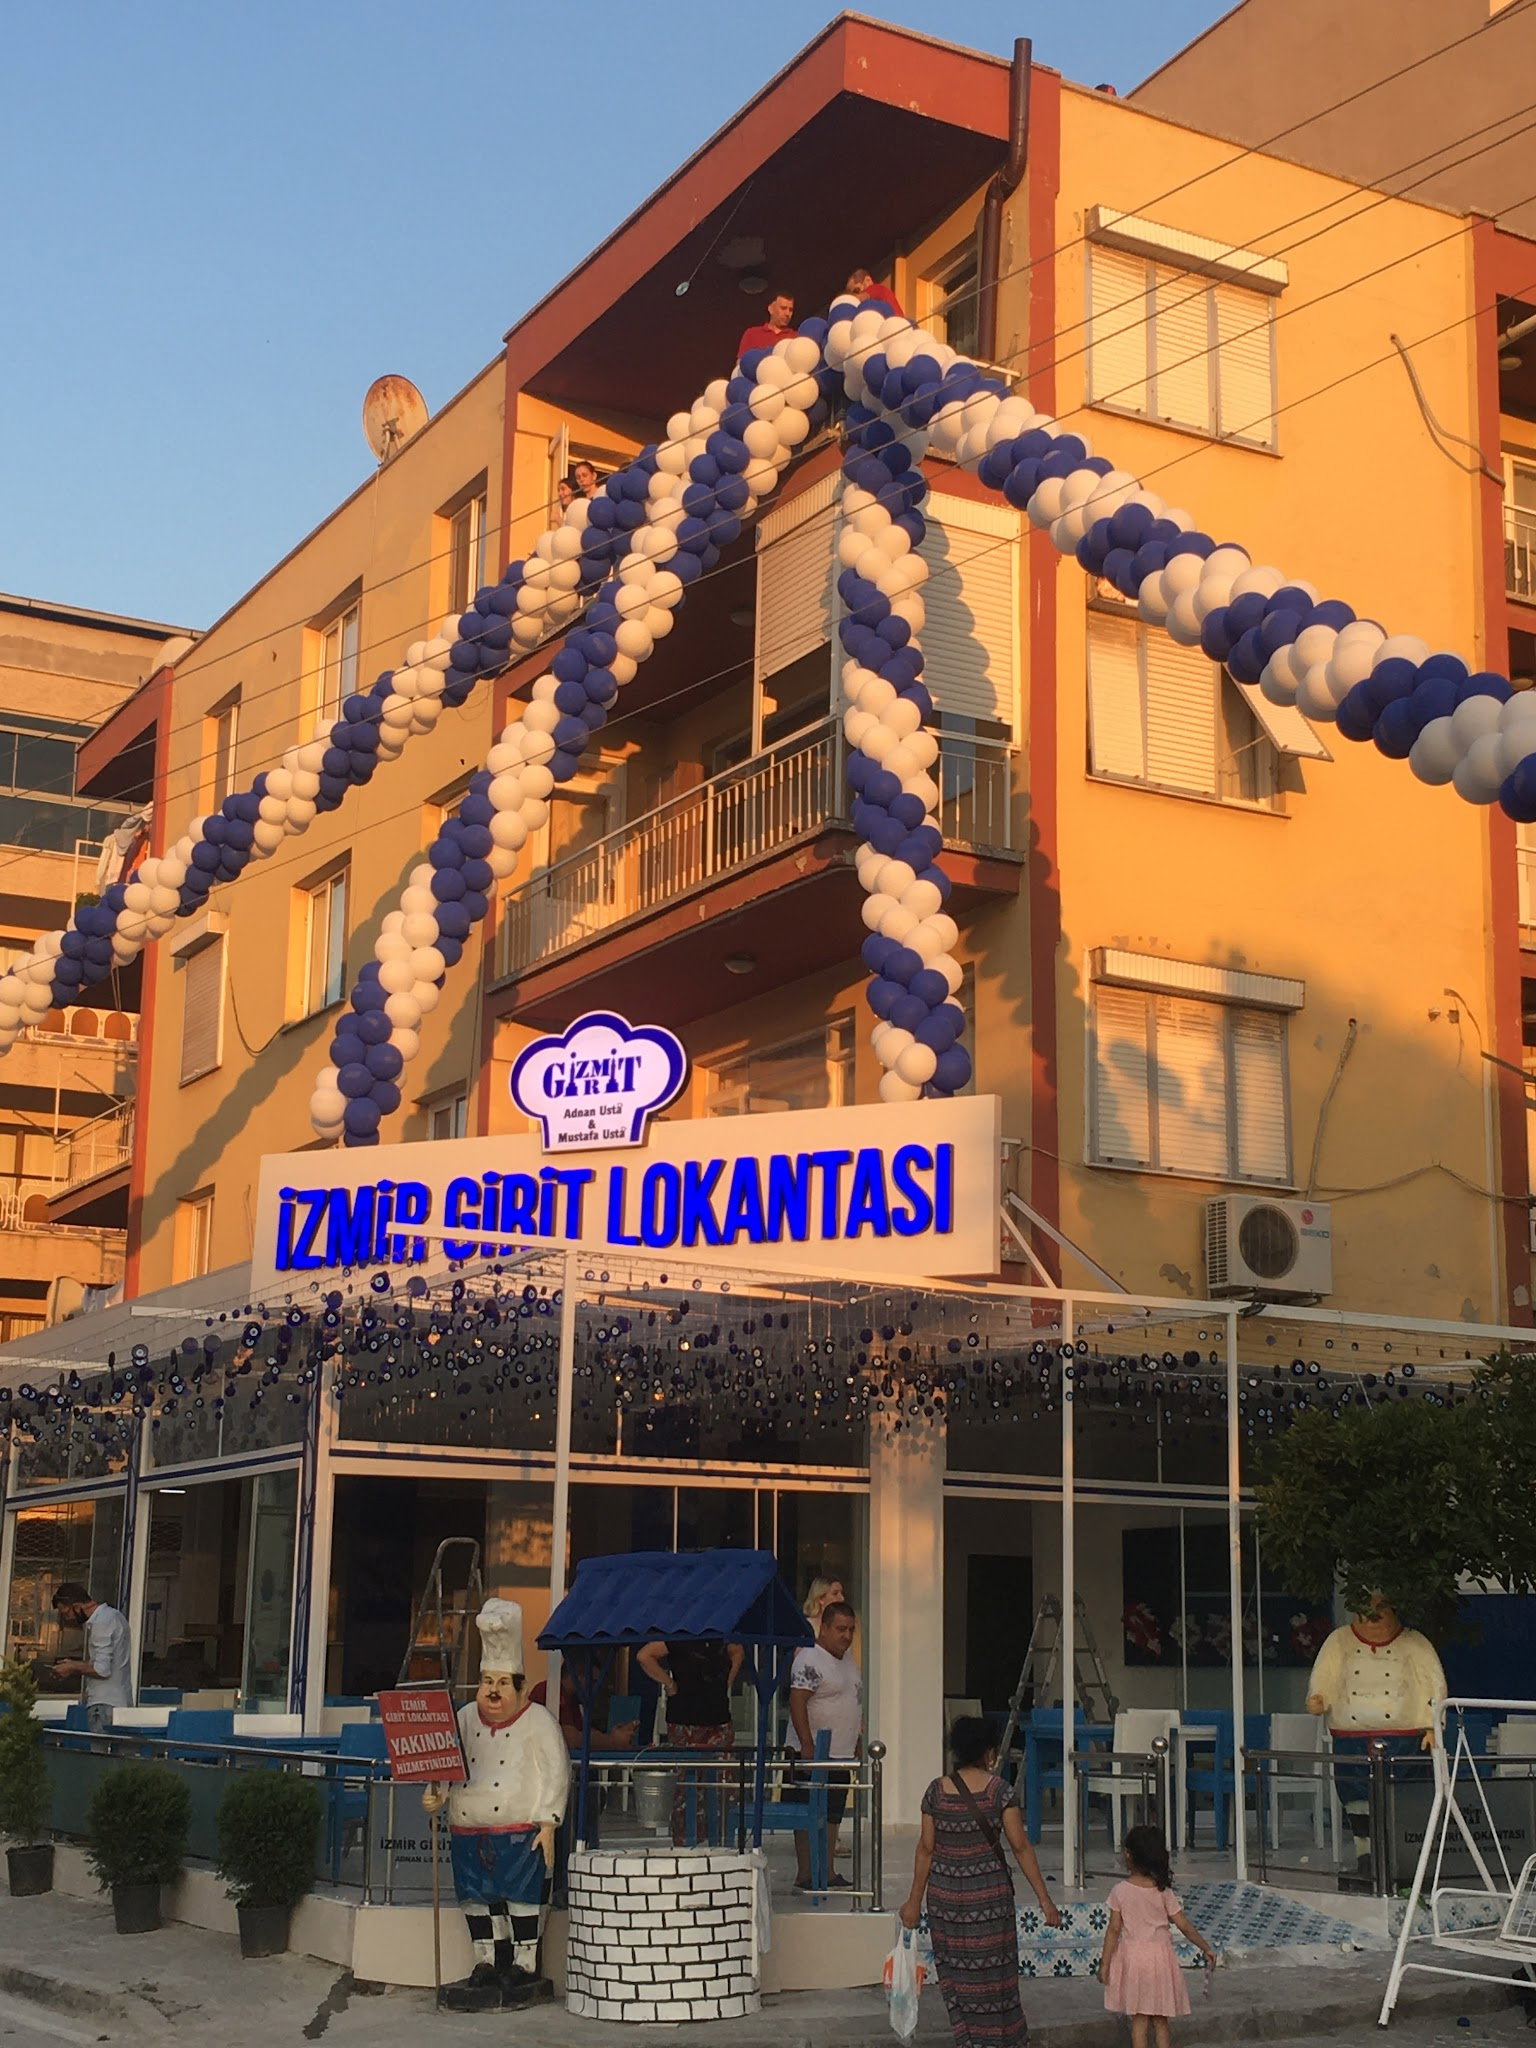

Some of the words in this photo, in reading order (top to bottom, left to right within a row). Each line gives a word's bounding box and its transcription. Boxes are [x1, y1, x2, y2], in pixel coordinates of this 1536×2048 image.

[563, 1108, 596, 1119] Adnan
[587, 1119, 596, 1129] &
[557, 1130, 599, 1143] Mustafa
[275, 1186, 431, 1271] İZMİR
[443, 1166, 596, 1260] GİRİT
[607, 1142, 954, 1248] LOKANTASI
[407, 1711, 450, 1723] LOKANTASI
[390, 1730, 456, 1757] YAKINDA
[380, 1836, 416, 1850] İZMİR
